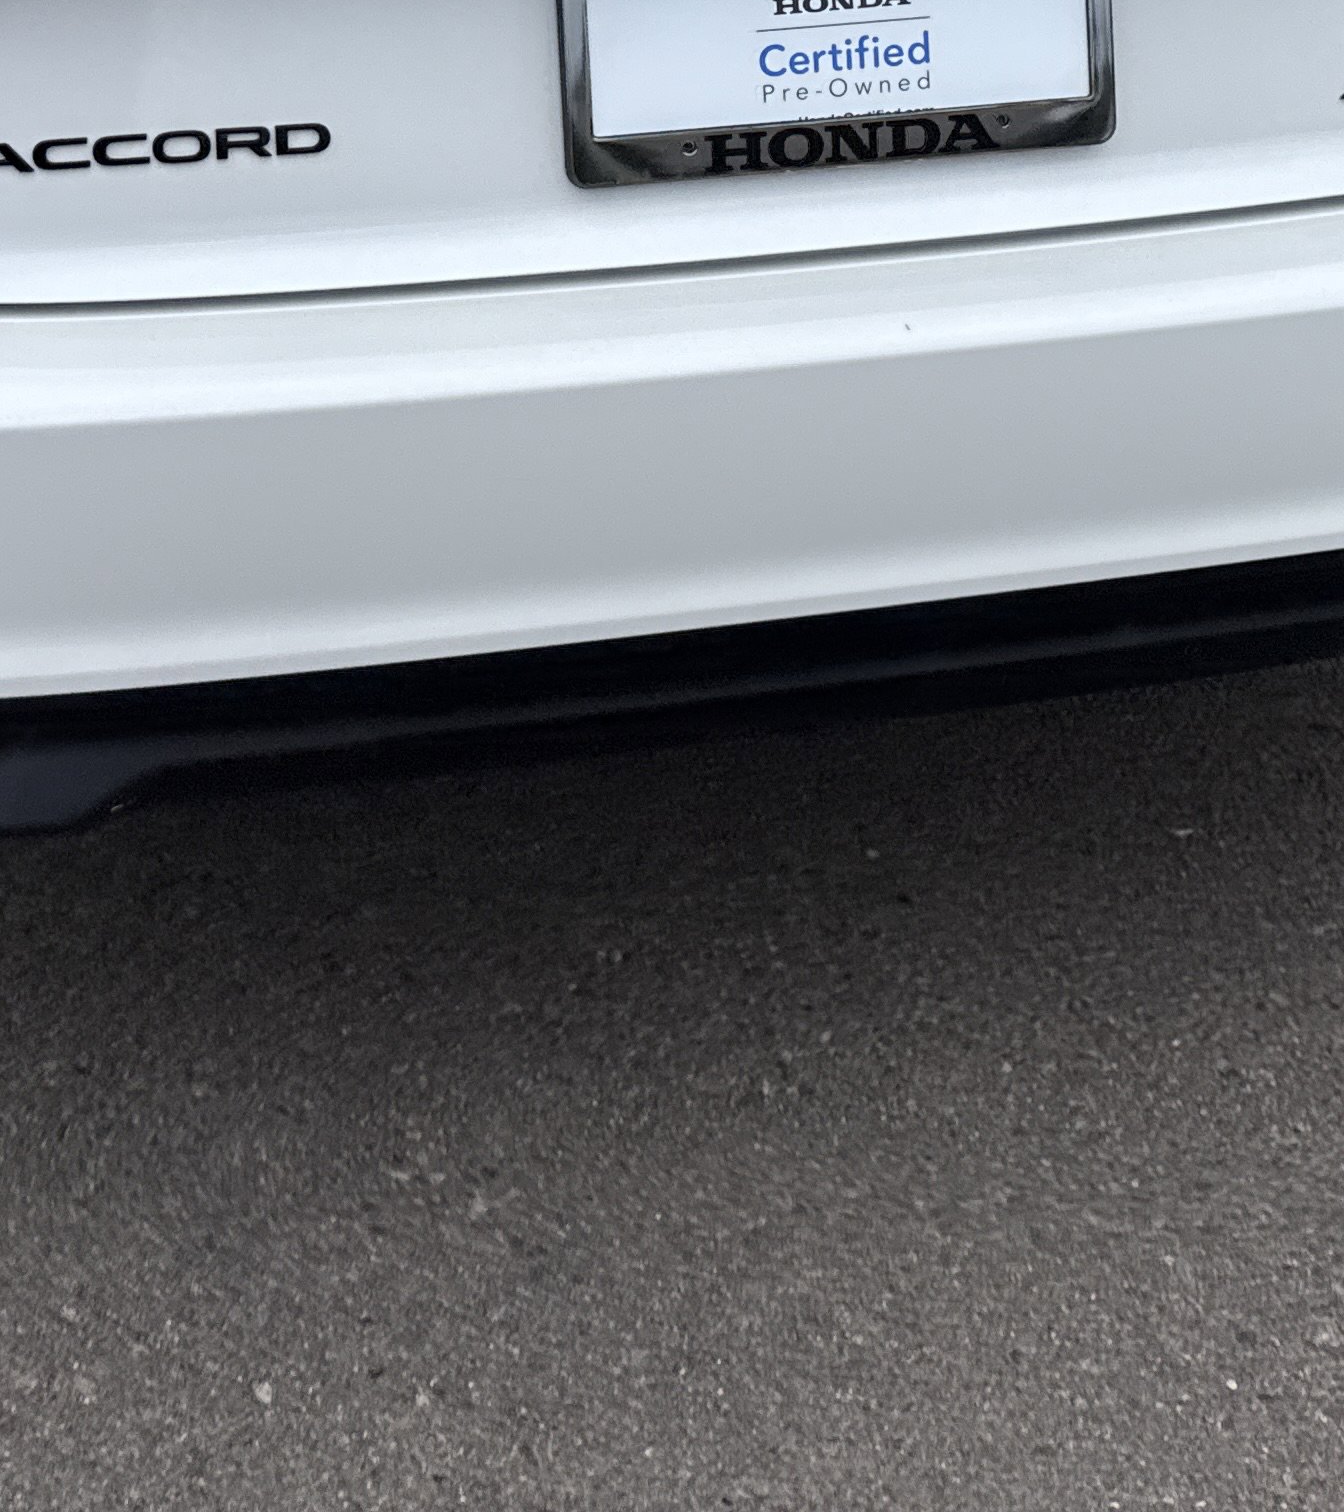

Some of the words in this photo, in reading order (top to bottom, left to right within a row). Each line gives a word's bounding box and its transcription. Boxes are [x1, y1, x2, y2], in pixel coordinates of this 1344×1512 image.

[759, 30, 931, 77] Certified
[762, 70, 931, 103] Pre-Owned
[704, 114, 1000, 173] HONDA
